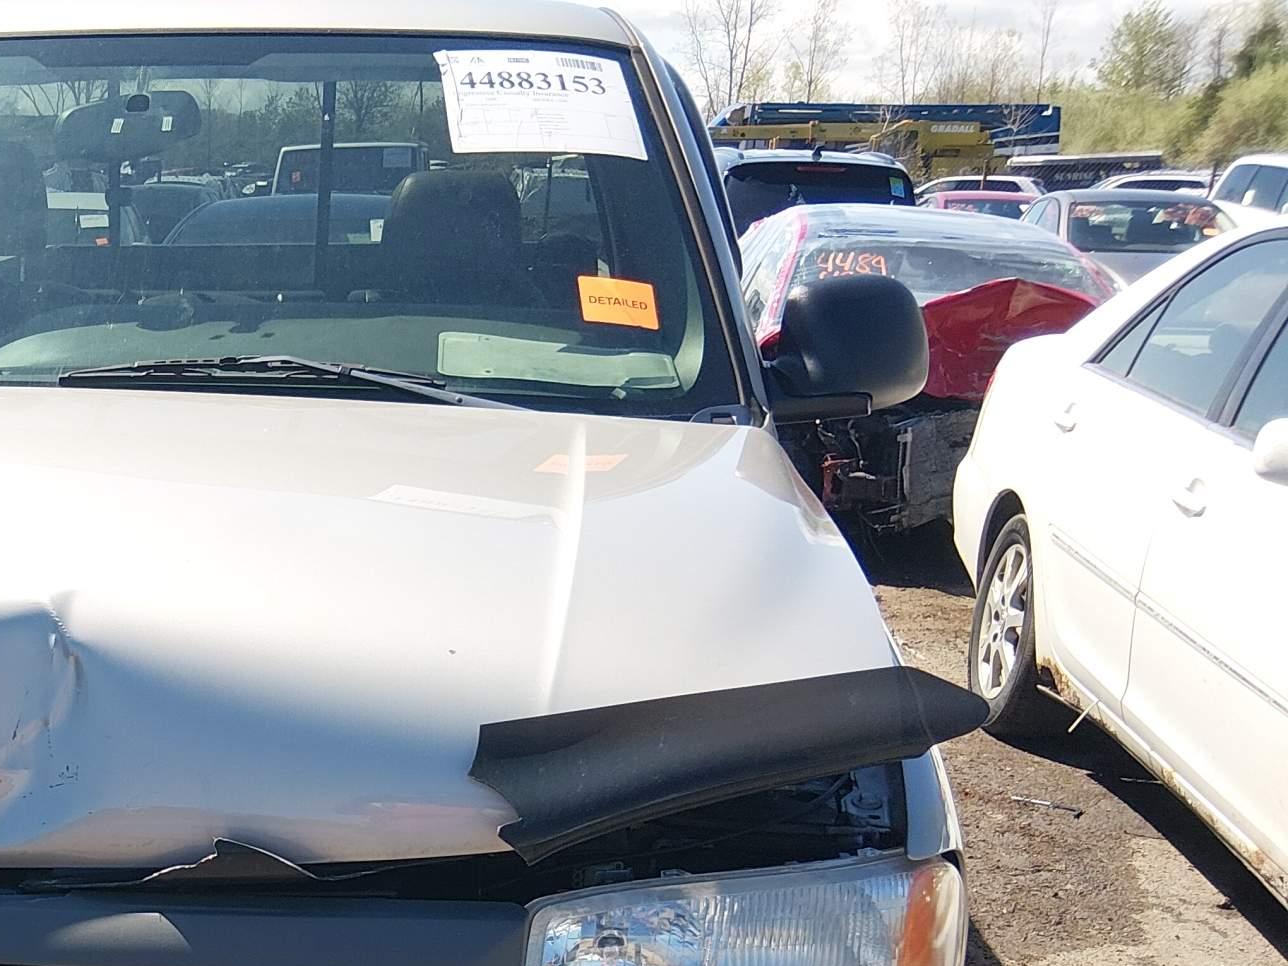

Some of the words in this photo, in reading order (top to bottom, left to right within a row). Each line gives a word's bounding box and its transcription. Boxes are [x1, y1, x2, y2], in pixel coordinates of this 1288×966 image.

[460, 71, 606, 95] 44883153
[816, 251, 887, 276] 4489
[588, 295, 648, 310] DETAILED
